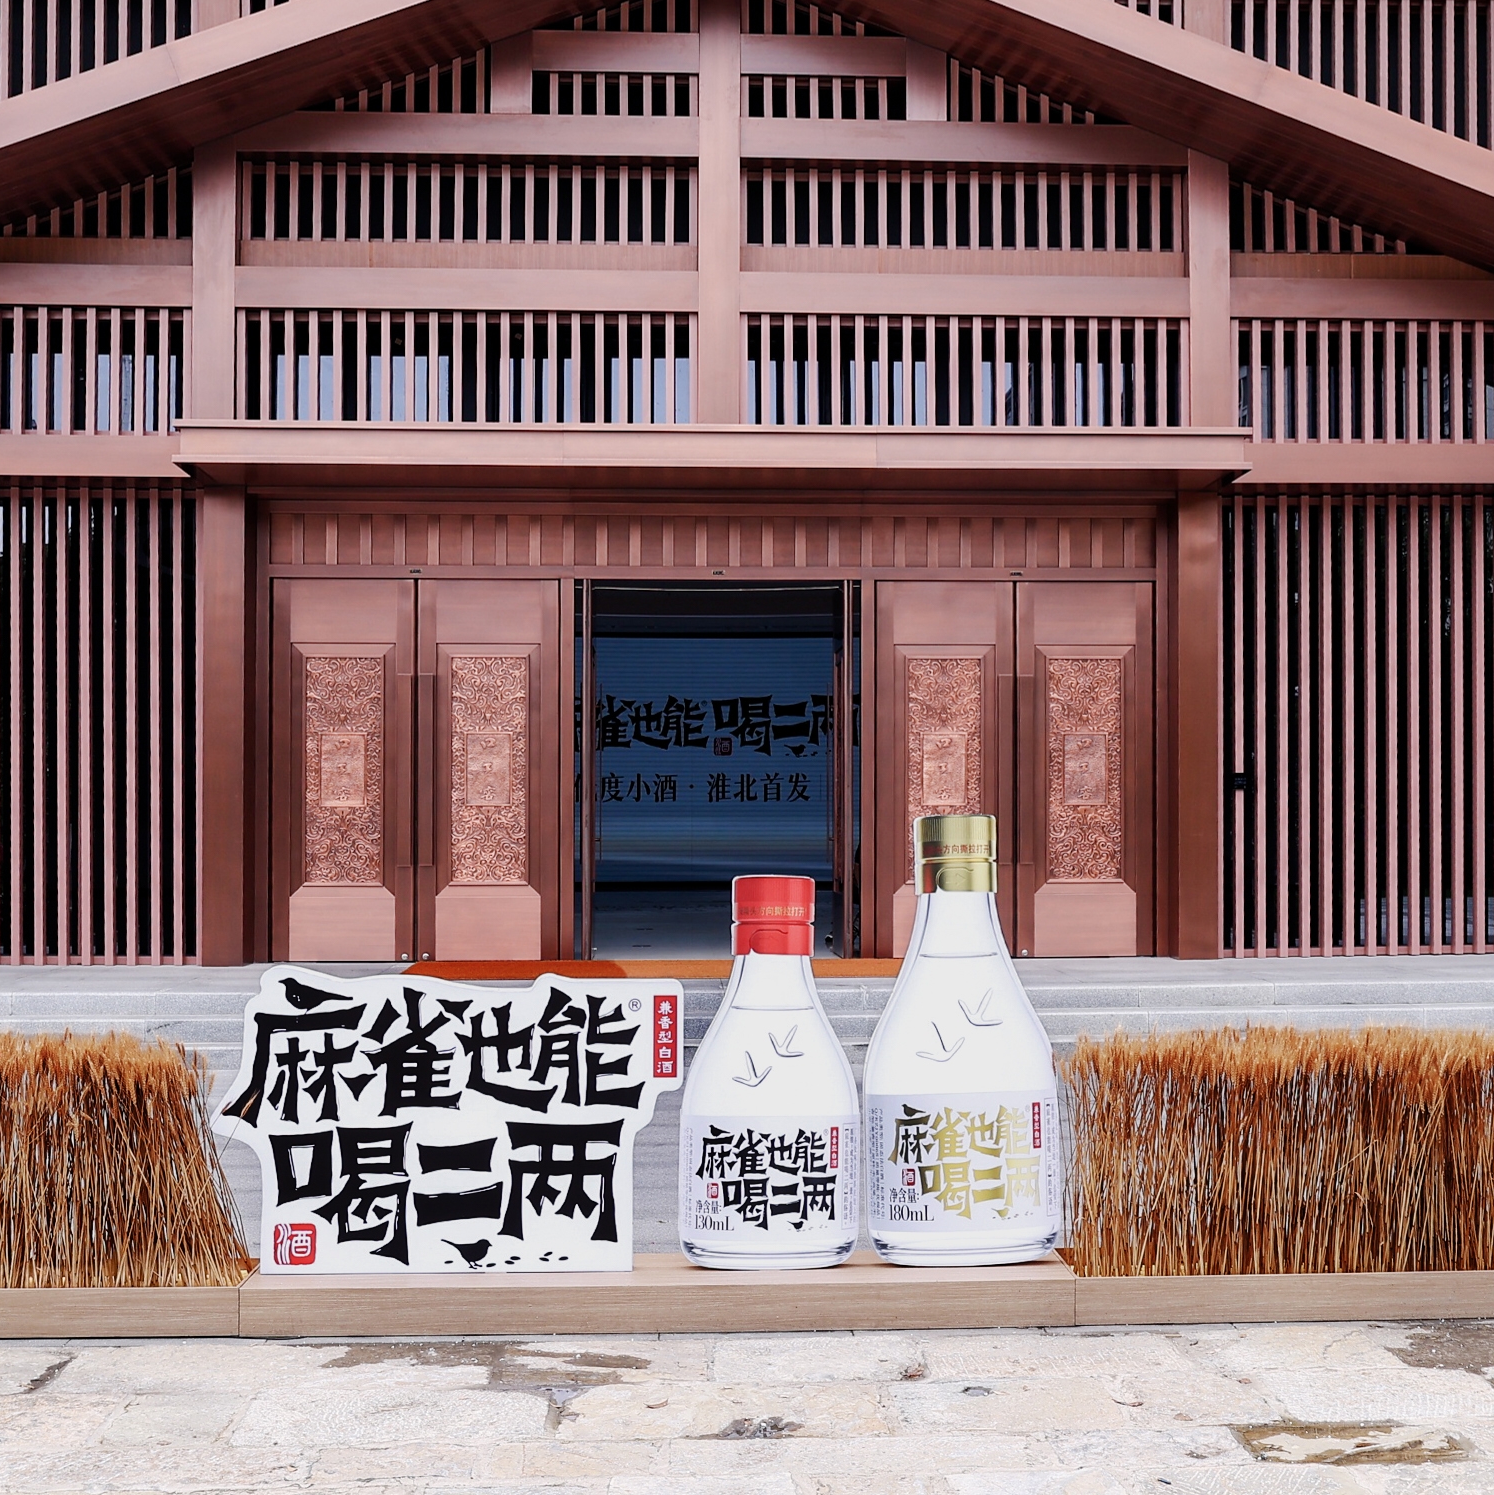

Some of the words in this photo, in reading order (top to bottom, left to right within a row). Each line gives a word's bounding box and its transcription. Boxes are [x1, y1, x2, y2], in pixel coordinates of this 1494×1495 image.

[222, 976, 645, 1128] 麻雀也能
[656, 998, 674, 1075] 兼香型白酒
[695, 1124, 828, 1179] 麻雀也能
[888, 1103, 1031, 1166] 麻雀也能
[269, 1118, 624, 1266] 喝二两
[721, 1174, 838, 1231] 喝二两
[889, 1204, 935, 1222] 180mL
[918, 1154, 1041, 1220] 喝二两
[694, 1215, 735, 1231] 130mL
